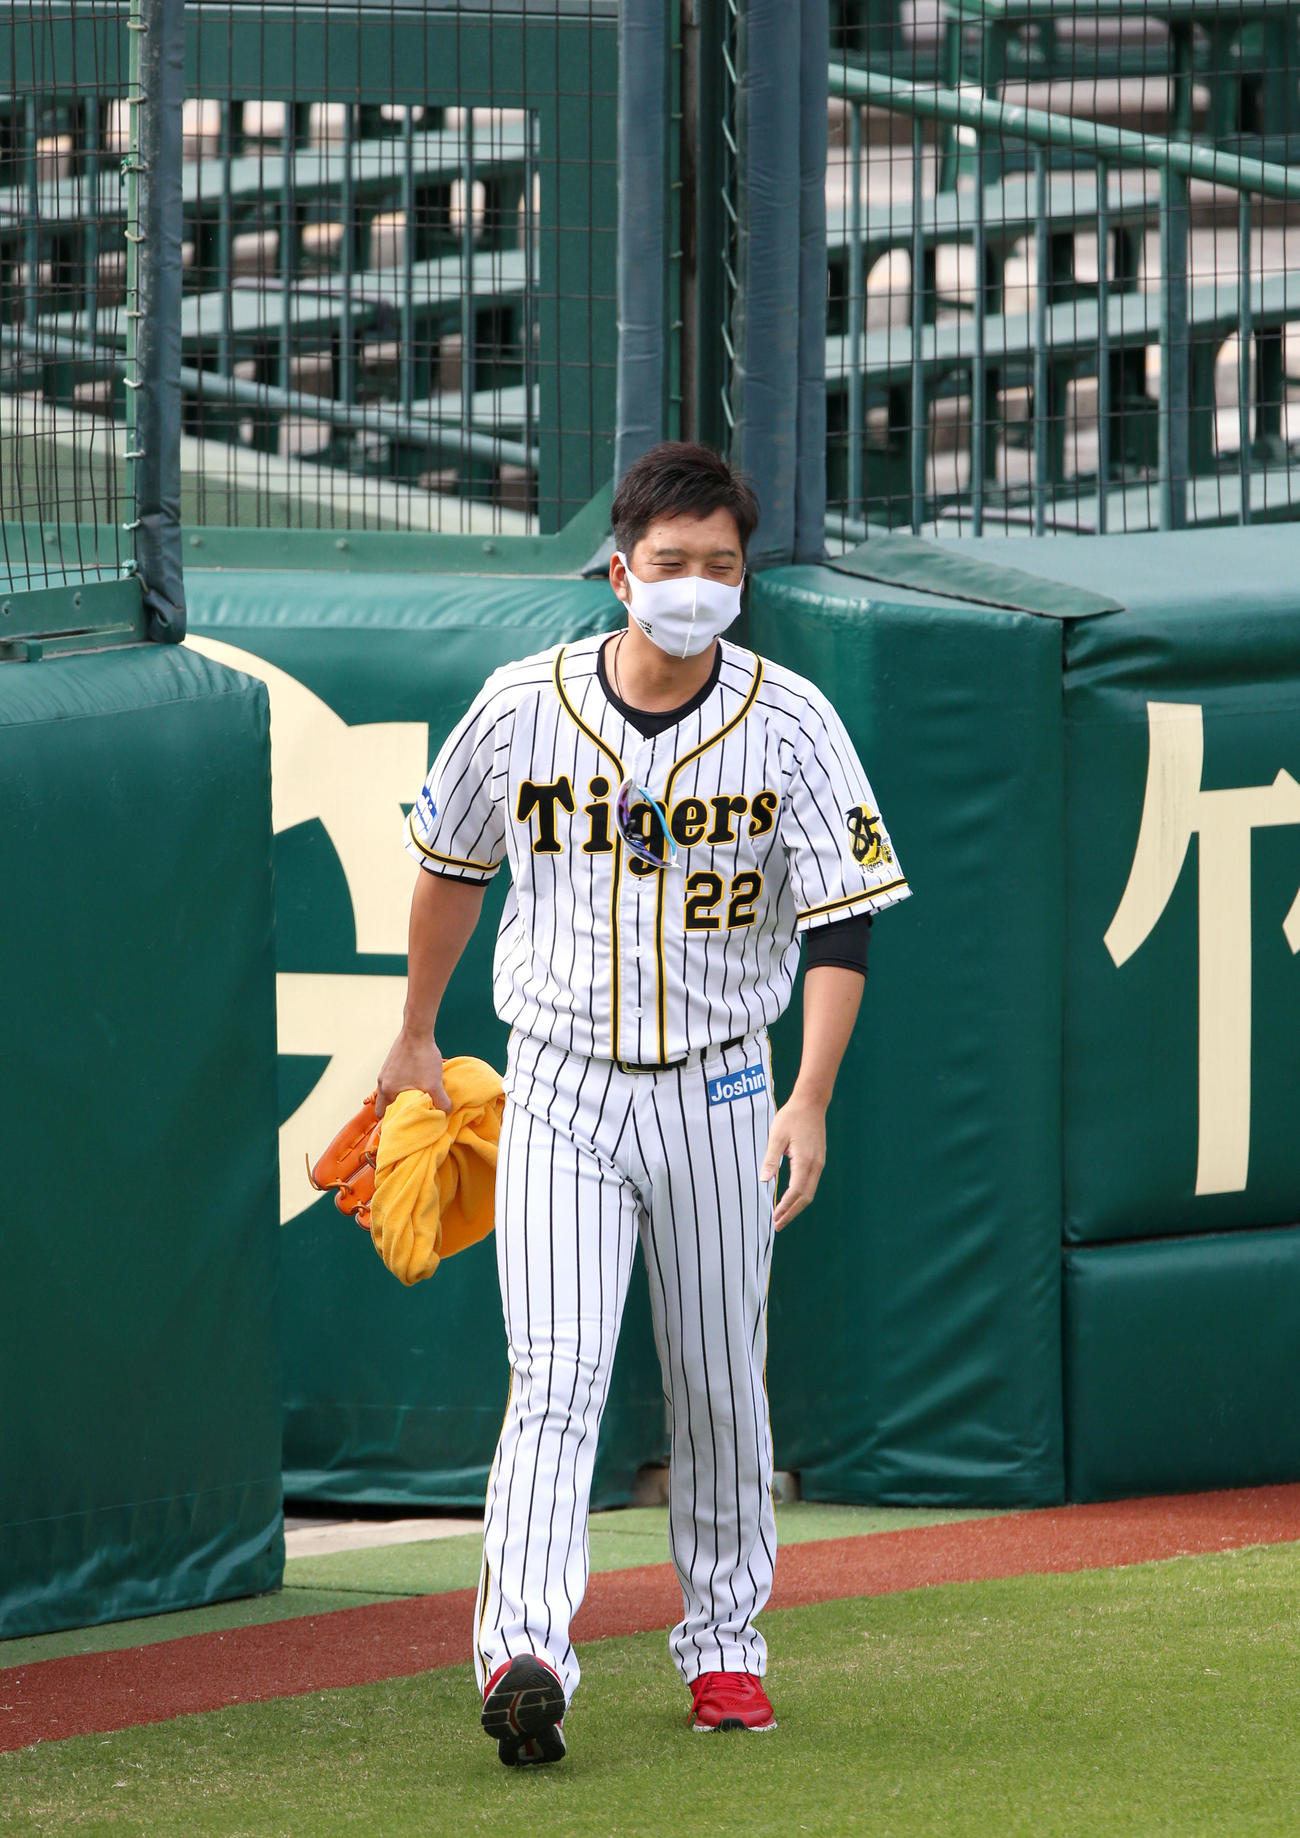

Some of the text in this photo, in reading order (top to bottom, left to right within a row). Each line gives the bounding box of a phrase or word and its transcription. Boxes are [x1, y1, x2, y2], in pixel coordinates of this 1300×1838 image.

[516, 775, 778, 877] Tigers
[845, 806, 881, 862] 85
[684, 870, 763, 931] 22
[711, 1069, 766, 1102] Joshin
